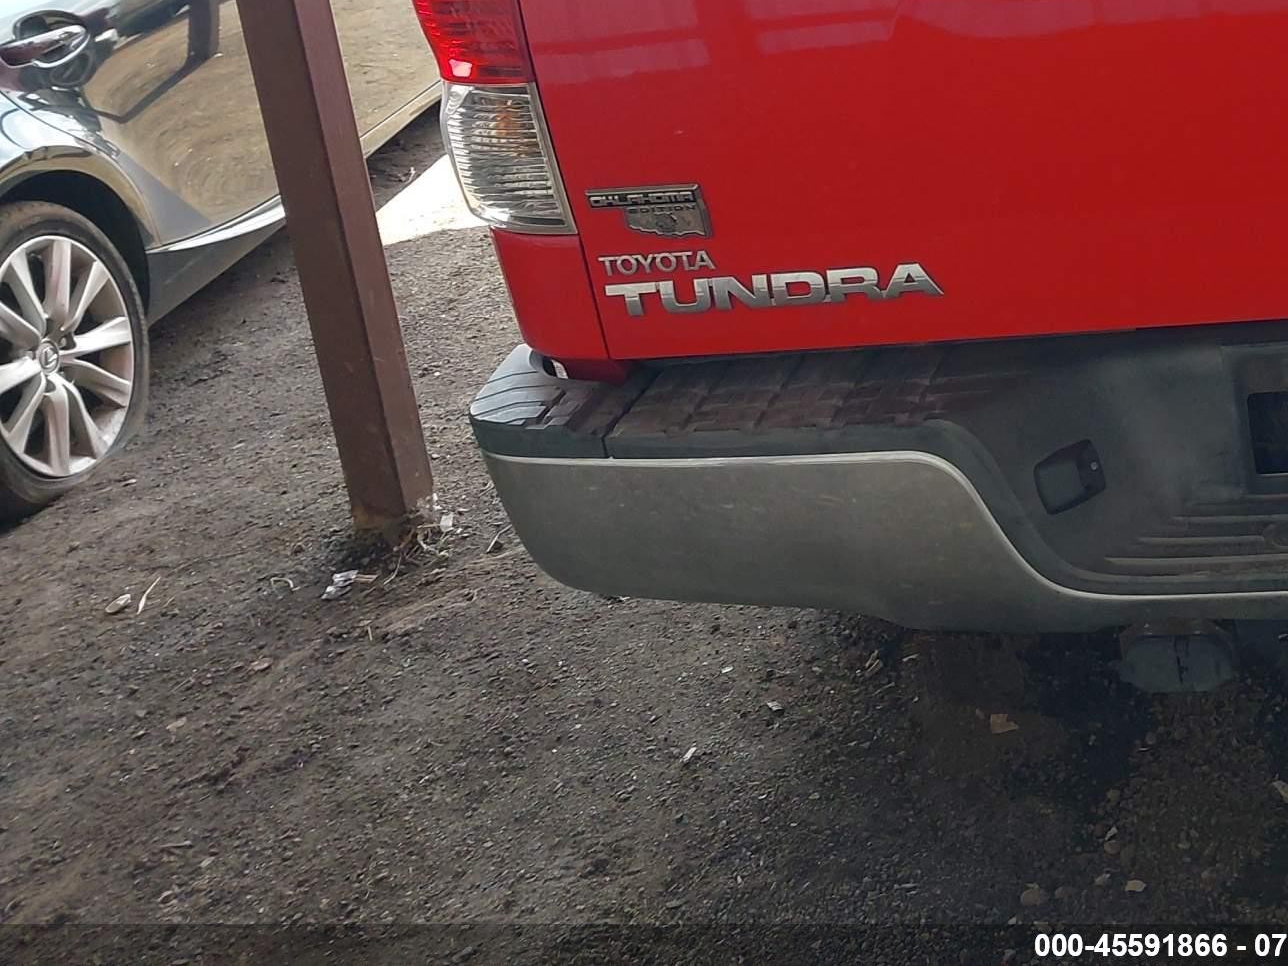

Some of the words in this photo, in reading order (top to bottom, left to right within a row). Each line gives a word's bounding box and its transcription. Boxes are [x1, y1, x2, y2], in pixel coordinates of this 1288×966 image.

[627, 204, 696, 214] EDITION
[598, 250, 715, 276] TOYOTA
[605, 263, 944, 317] TUNDRA
